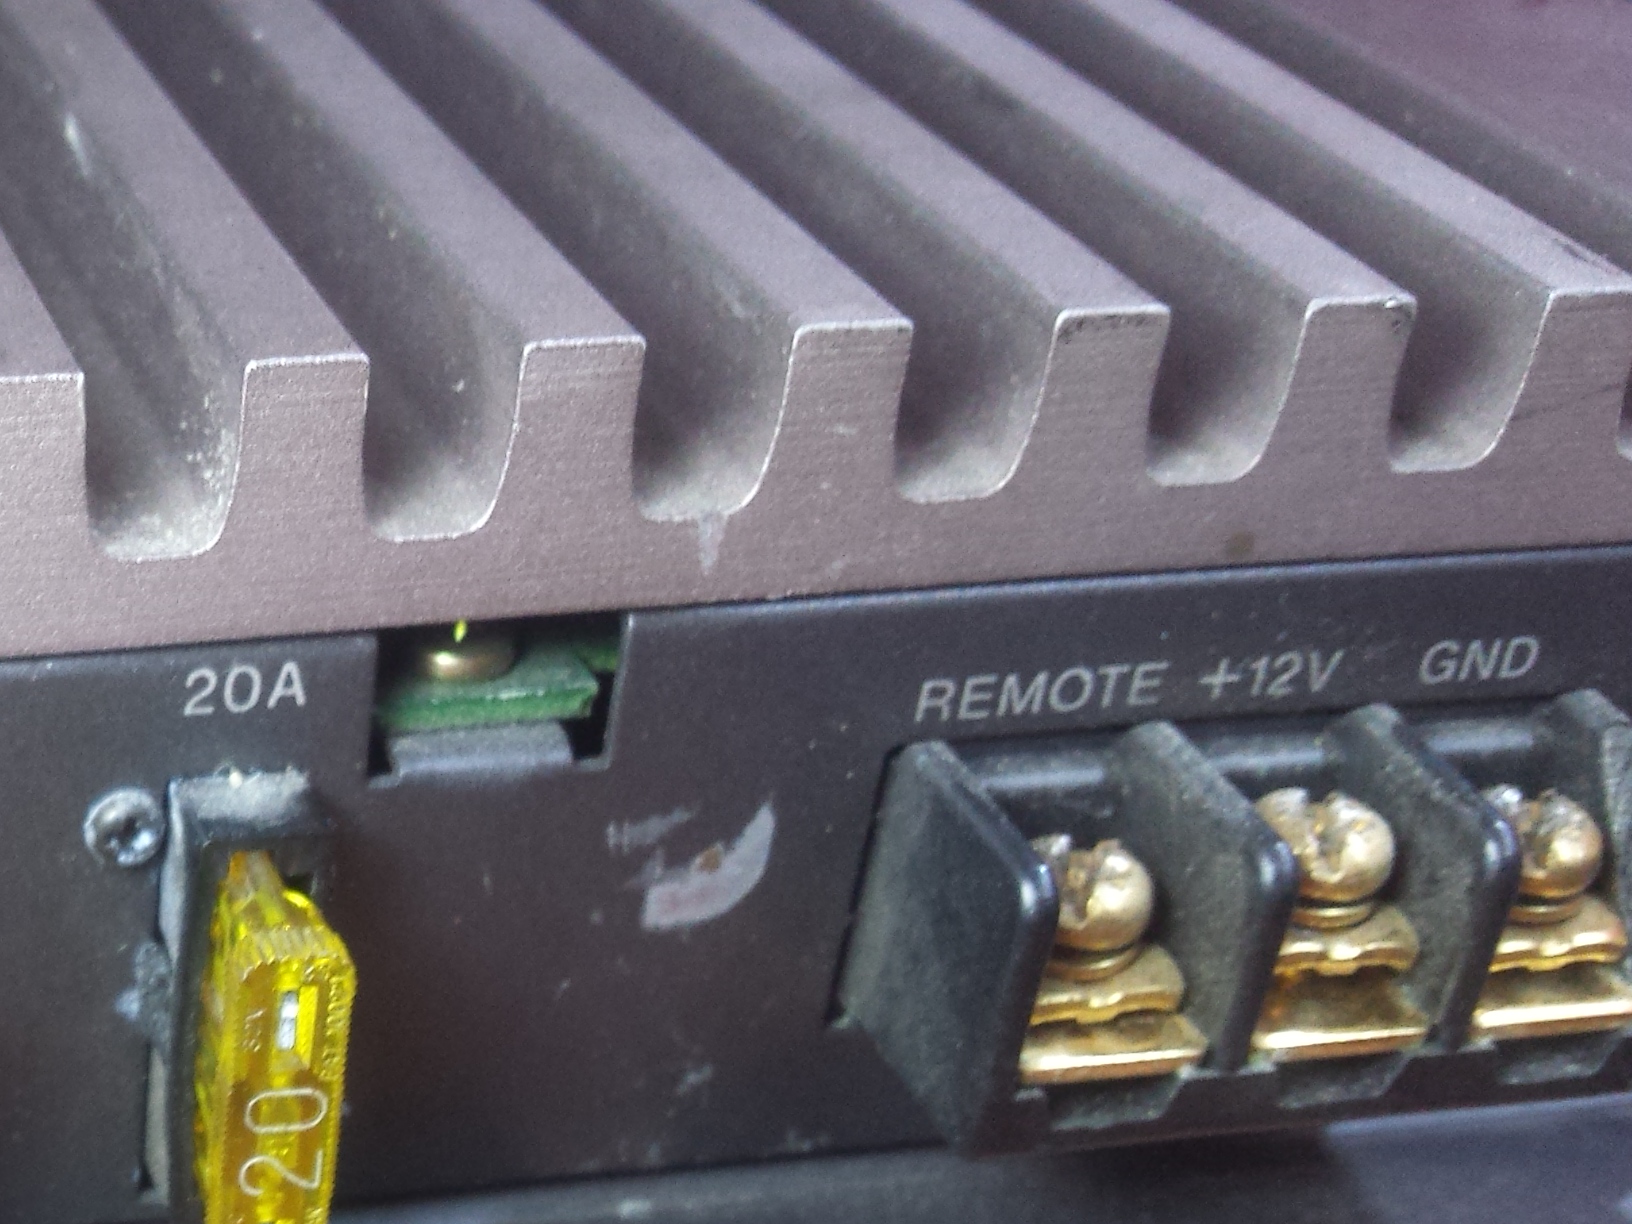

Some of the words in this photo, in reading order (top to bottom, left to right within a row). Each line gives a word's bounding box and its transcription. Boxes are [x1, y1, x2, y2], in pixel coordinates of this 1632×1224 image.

[182, 660, 309, 717] 20A
[1199, 648, 1347, 699] +12V
[1419, 635, 1542, 685] GND
[913, 660, 1172, 724] REMOTE
[238, 1085, 329, 1198] 20
